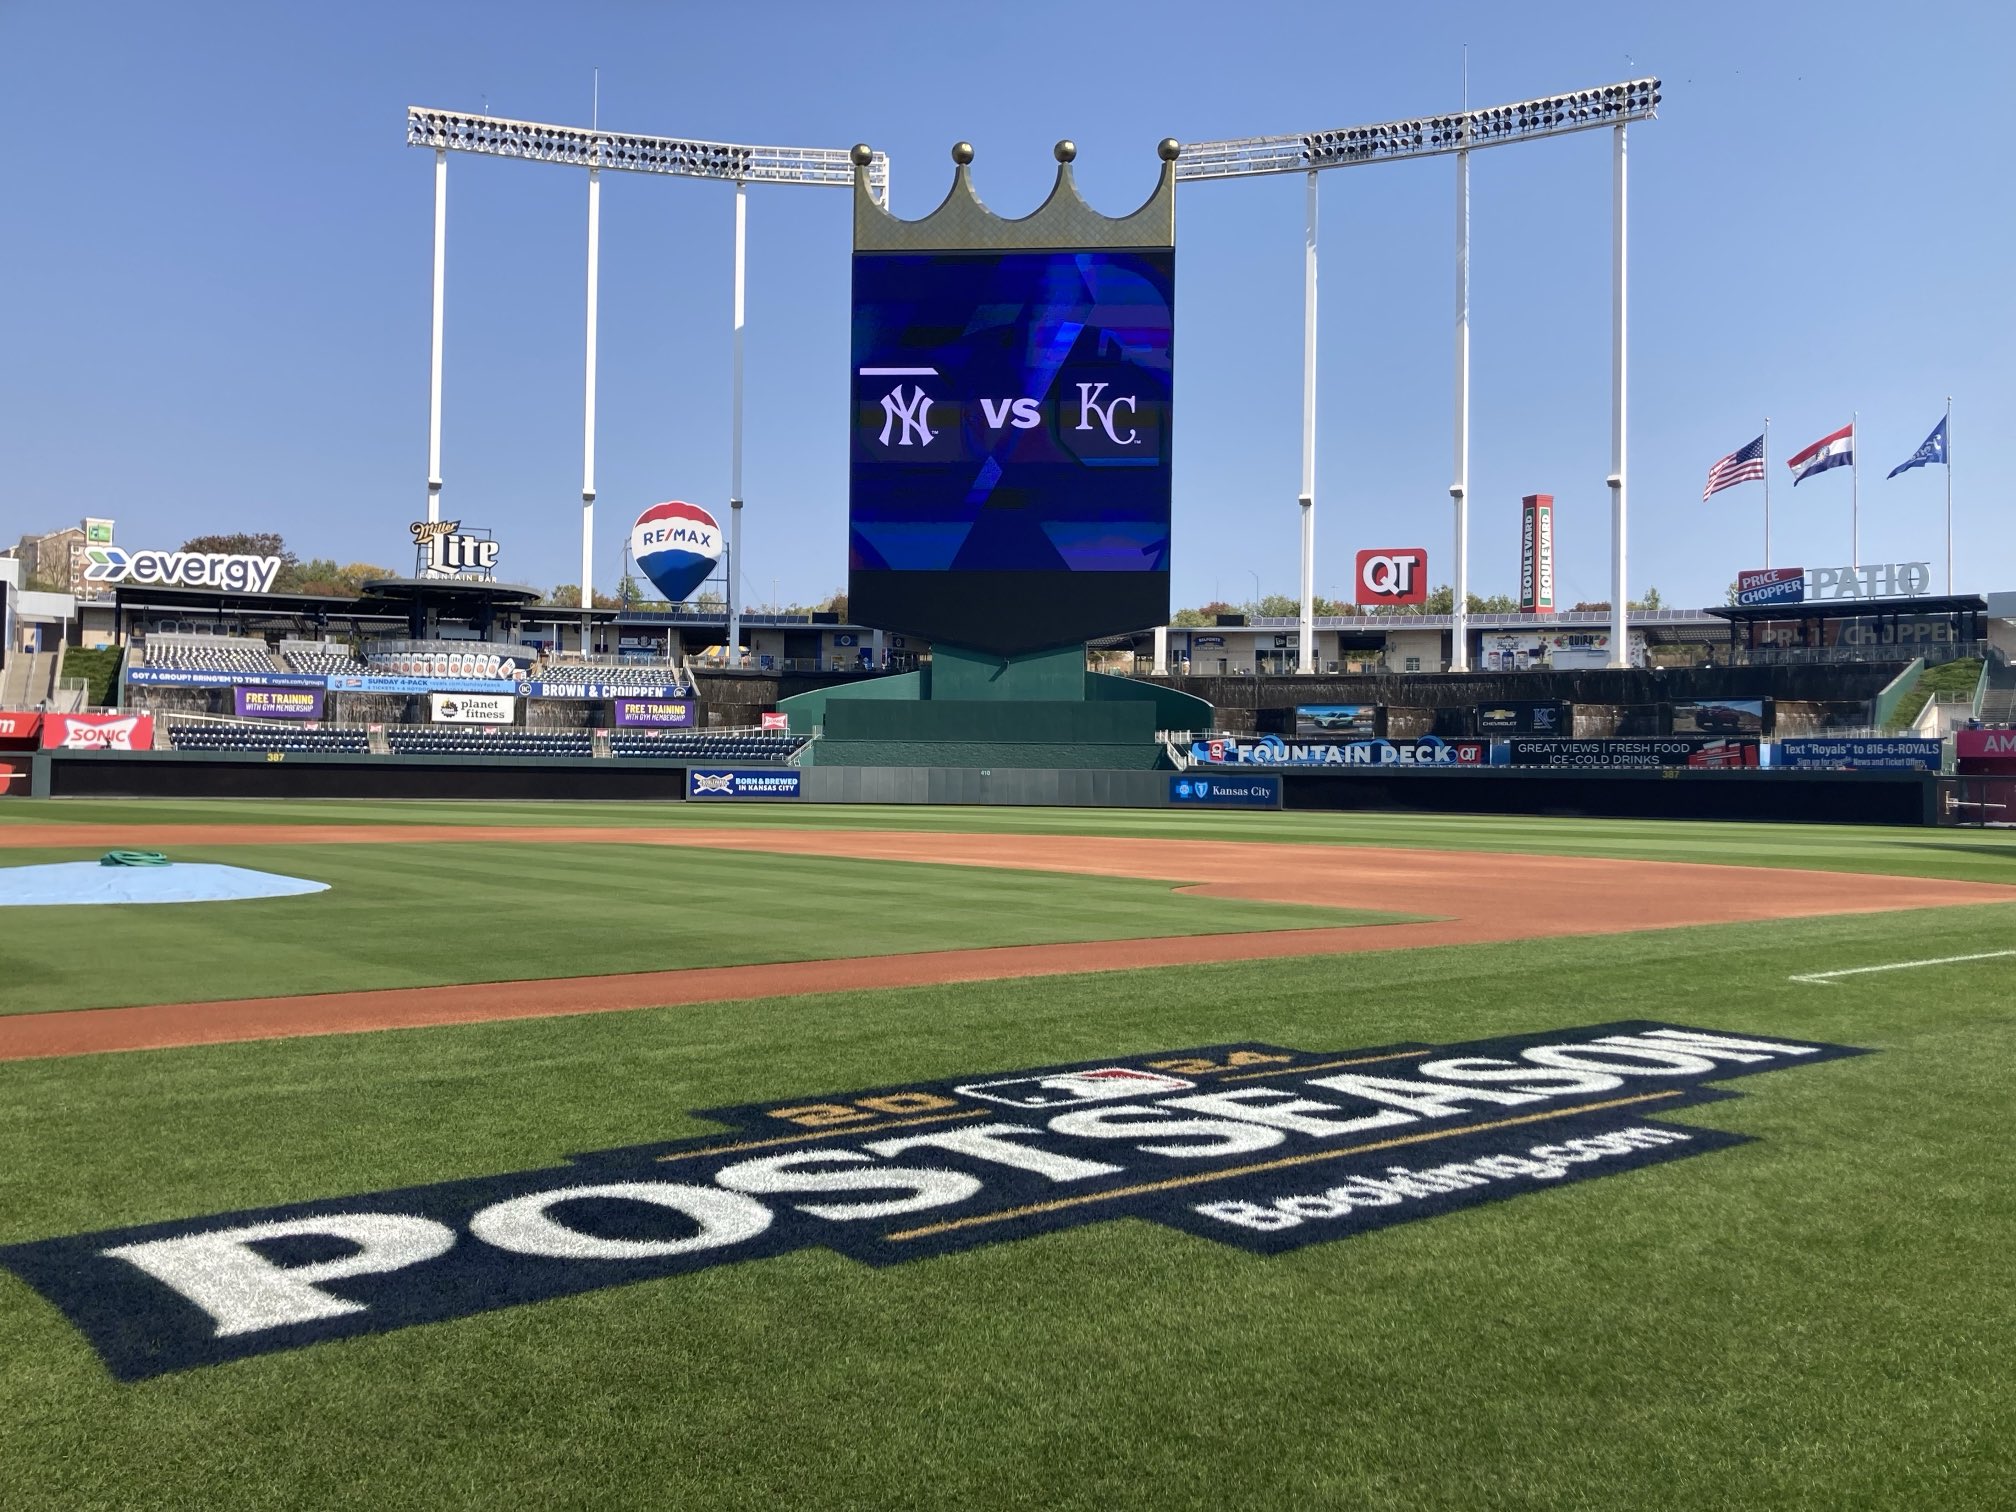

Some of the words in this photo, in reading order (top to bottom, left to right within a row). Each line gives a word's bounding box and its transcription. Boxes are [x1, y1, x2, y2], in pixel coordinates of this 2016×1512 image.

[1075, 383, 1136, 444] KC
[411, 521, 459, 543] Miller
[643, 528, 711, 548] RE/MAX
[428, 533, 499, 574] Lite
[1523, 515, 1532, 598] BOULEVARD
[1541, 514, 1550, 598] BOULEVARD
[134, 555, 276, 592] evergy
[419, 572, 473, 580] FOUNTAIN
[478, 574, 497, 583] BAR
[1362, 556, 1416, 595] QT
[1742, 571, 1780, 589] PRICE
[1812, 562, 1930, 599] PATIO
[1741, 580, 1802, 604] CHOPPER
[159, 673, 191, 681] GROUP?
[542, 684, 585, 697] BROWN
[588, 686, 599, 697] &
[246, 692, 269, 704] FREE
[271, 694, 314, 704] TRAINING
[461, 699, 498, 710] planet
[246, 703, 261, 711] WITH
[262, 704, 275, 712] GYM
[276, 704, 314, 713] MEMBERSHIP
[466, 709, 505, 719] fitness
[625, 704, 646, 713] FREE
[647, 704, 686, 714] TRAINING
[625, 713, 639, 721] WITH
[640, 713, 651, 721] GYM
[652, 714, 686, 722] MEMBERSHIP
[71, 729, 127, 742] SONIC
[1238, 745, 1371, 763] FOUNTAIN
[1381, 745, 1453, 763] DECK
[1459, 747, 1478, 761] QT
[1518, 744, 1558, 753] GREAT
[1560, 744, 1600, 753] VIEWS
[1609, 744, 1650, 753] FRESH
[1654, 744, 1690, 753] FOOD
[1784, 744, 1805, 754] Text
[1853, 744, 1864, 754] to
[1866, 743, 1940, 754] 816-6-ROYALS
[267, 753, 285, 762] 387
[1550, 755, 1609, 764] ICE-COLD
[1613, 755, 1660, 764] DRINKS
[1797, 758, 1811, 767] Sign
[1213, 786, 1249, 796] Kansas
[1251, 786, 1271, 798] City
[101, 1028, 1822, 1337] POSTSEASON
[1195, 1124, 1695, 1232] Booking.com
